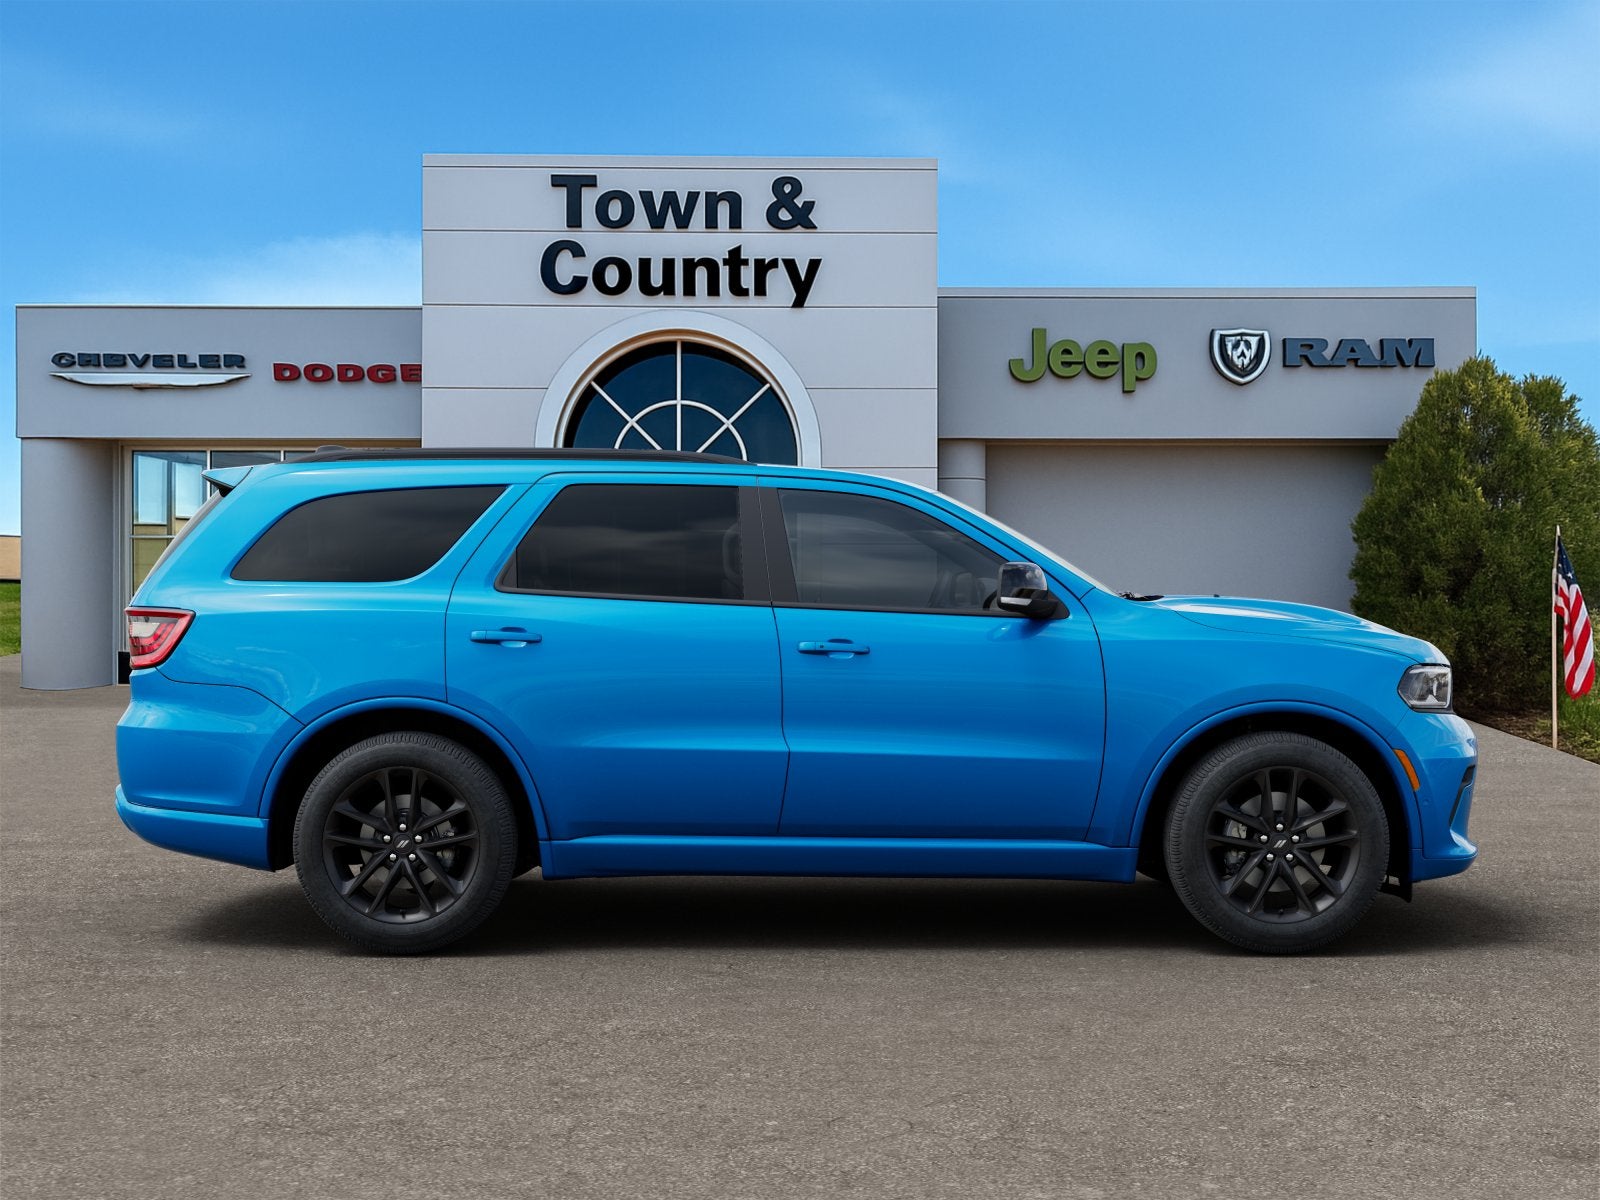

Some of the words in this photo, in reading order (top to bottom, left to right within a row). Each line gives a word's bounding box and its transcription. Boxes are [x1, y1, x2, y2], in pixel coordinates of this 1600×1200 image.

[550, 174, 743, 230] Town
[765, 176, 818, 230] &
[540, 239, 822, 308] Country
[273, 362, 422, 383] DODGE
[1009, 328, 1158, 393] Jeep
[1283, 337, 1436, 367] RAM
